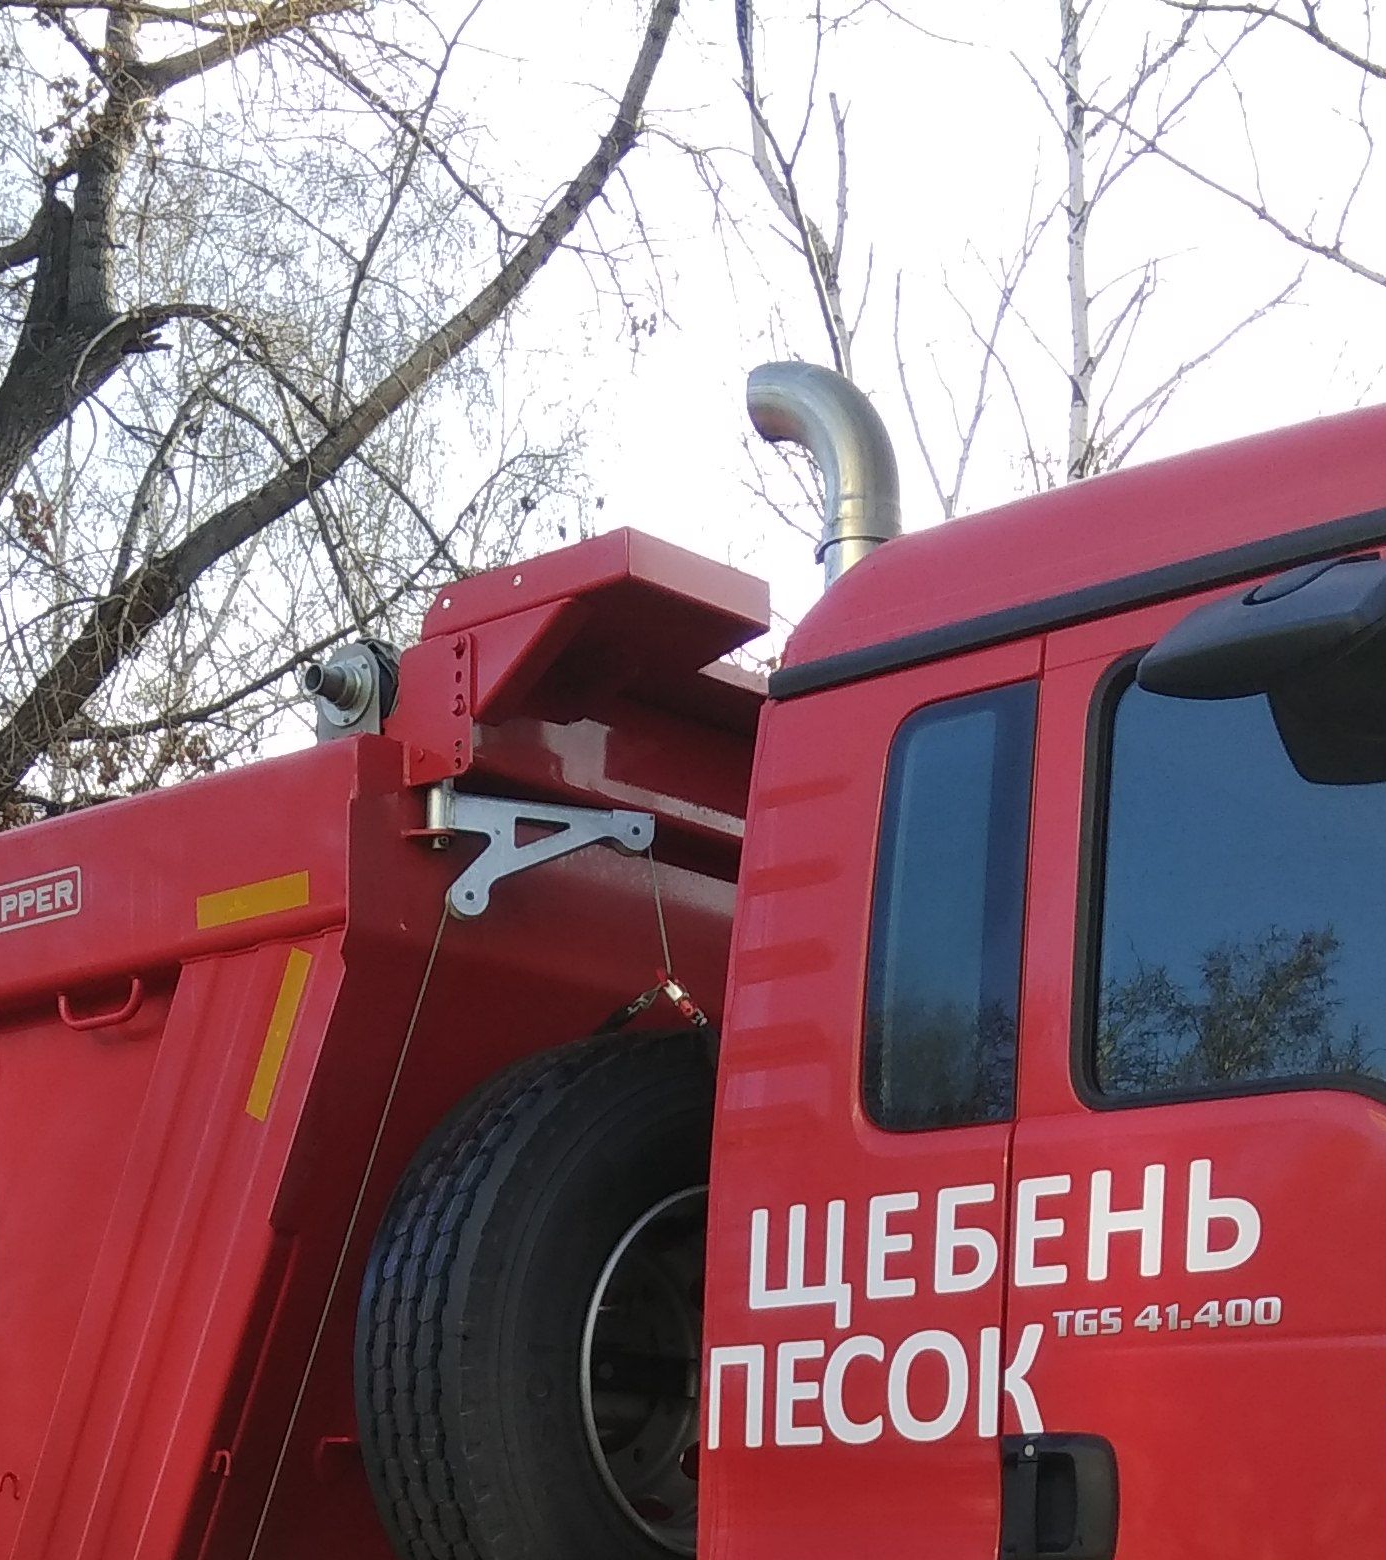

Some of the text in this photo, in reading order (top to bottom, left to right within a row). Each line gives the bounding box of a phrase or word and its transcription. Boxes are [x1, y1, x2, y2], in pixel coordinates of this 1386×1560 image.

[747, 1158, 1263, 1328] ЩЕБЕНЬ
[1052, 1296, 1282, 1338] TGS 41.400
[705, 1322, 1045, 1451] ПЕСОК
